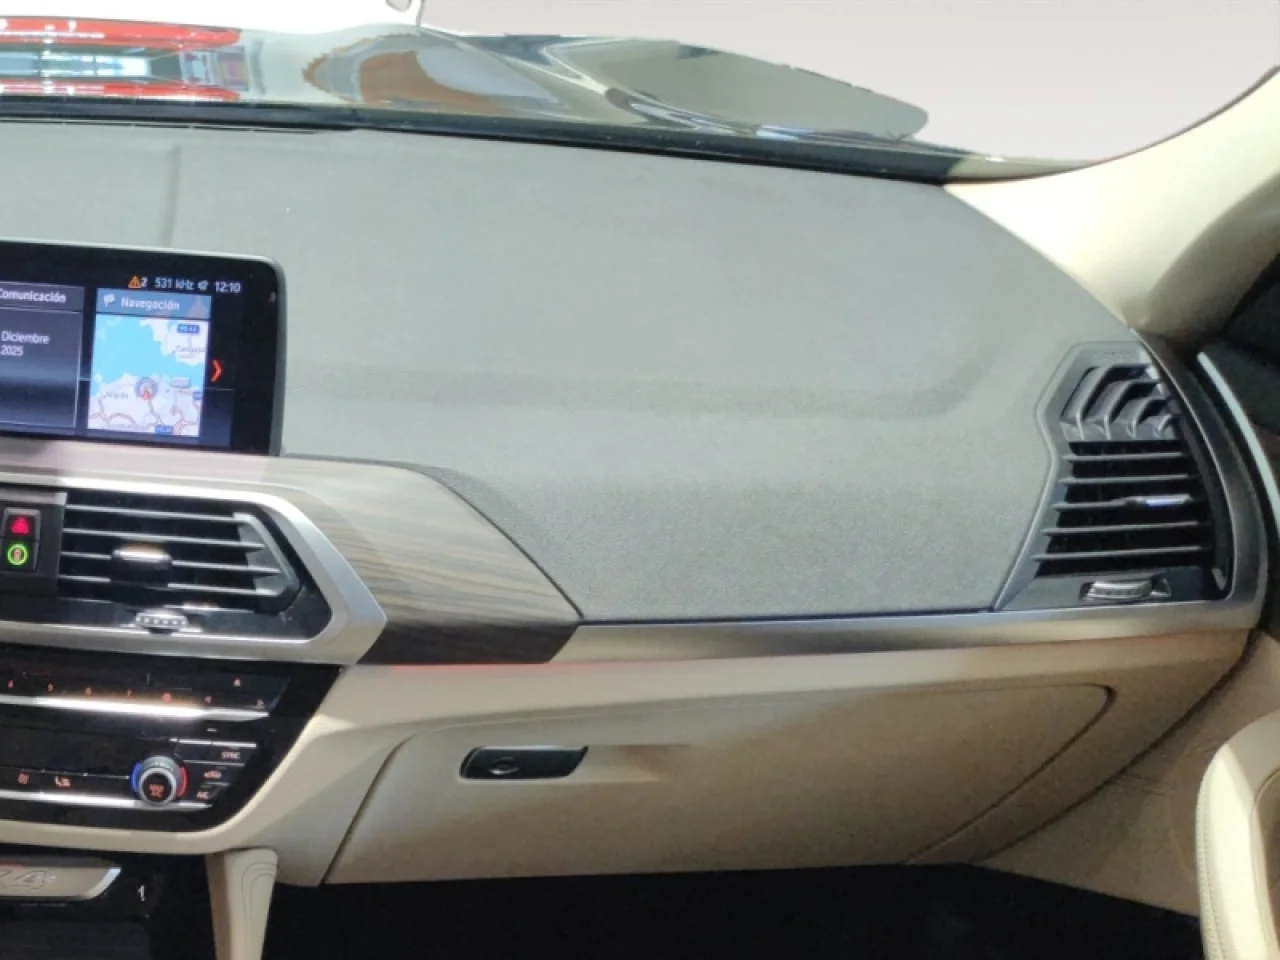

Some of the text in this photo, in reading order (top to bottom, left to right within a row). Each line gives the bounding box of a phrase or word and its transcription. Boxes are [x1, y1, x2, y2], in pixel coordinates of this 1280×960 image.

[154, 277, 172, 289] 531
[176, 279, 195, 291] kHz
[215, 281, 241, 294] 12:10
[122, 297, 180, 312] Navegación
[1, 330, 50, 345] Diciembre
[0, 344, 24, 357] 2025
